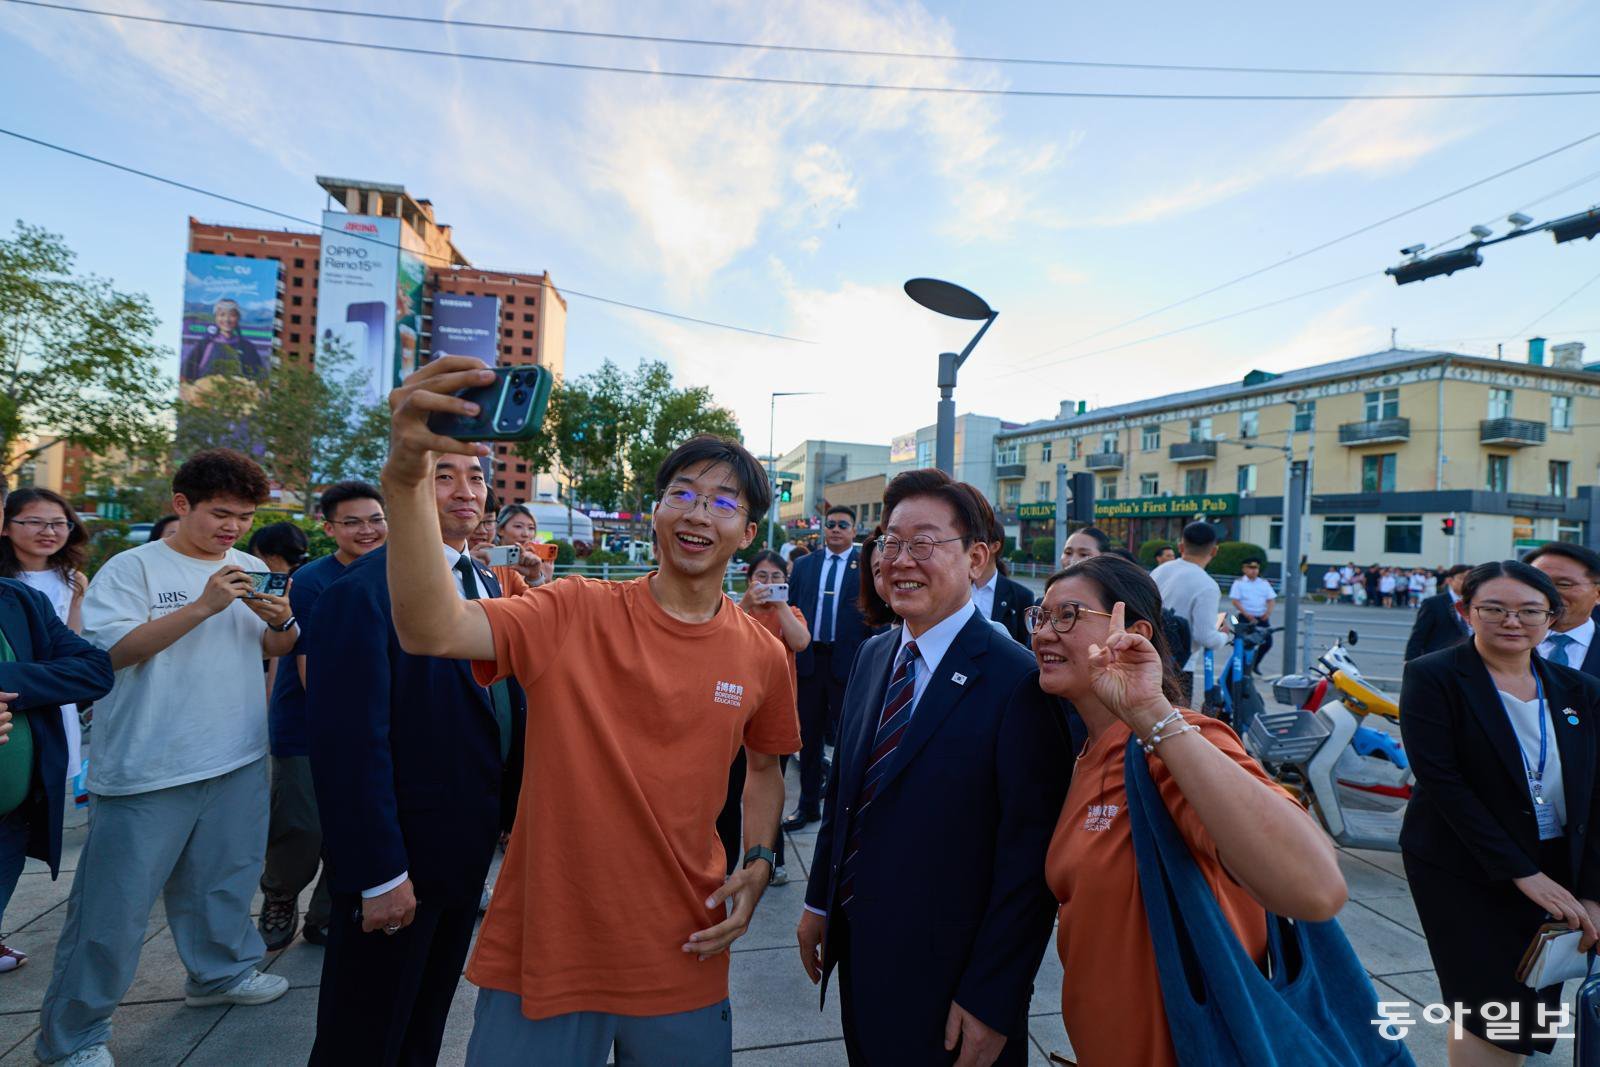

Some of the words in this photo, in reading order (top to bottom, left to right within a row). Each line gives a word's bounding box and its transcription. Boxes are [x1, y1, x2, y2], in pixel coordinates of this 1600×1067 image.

[326, 244, 368, 260] OPPO
[440, 299, 473, 308] SAMSUNG
[1143, 501, 1167, 513] First
[1171, 500, 1198, 513] Irish
[1202, 499, 1227, 512] Pub
[158, 591, 188, 603] IRIS
